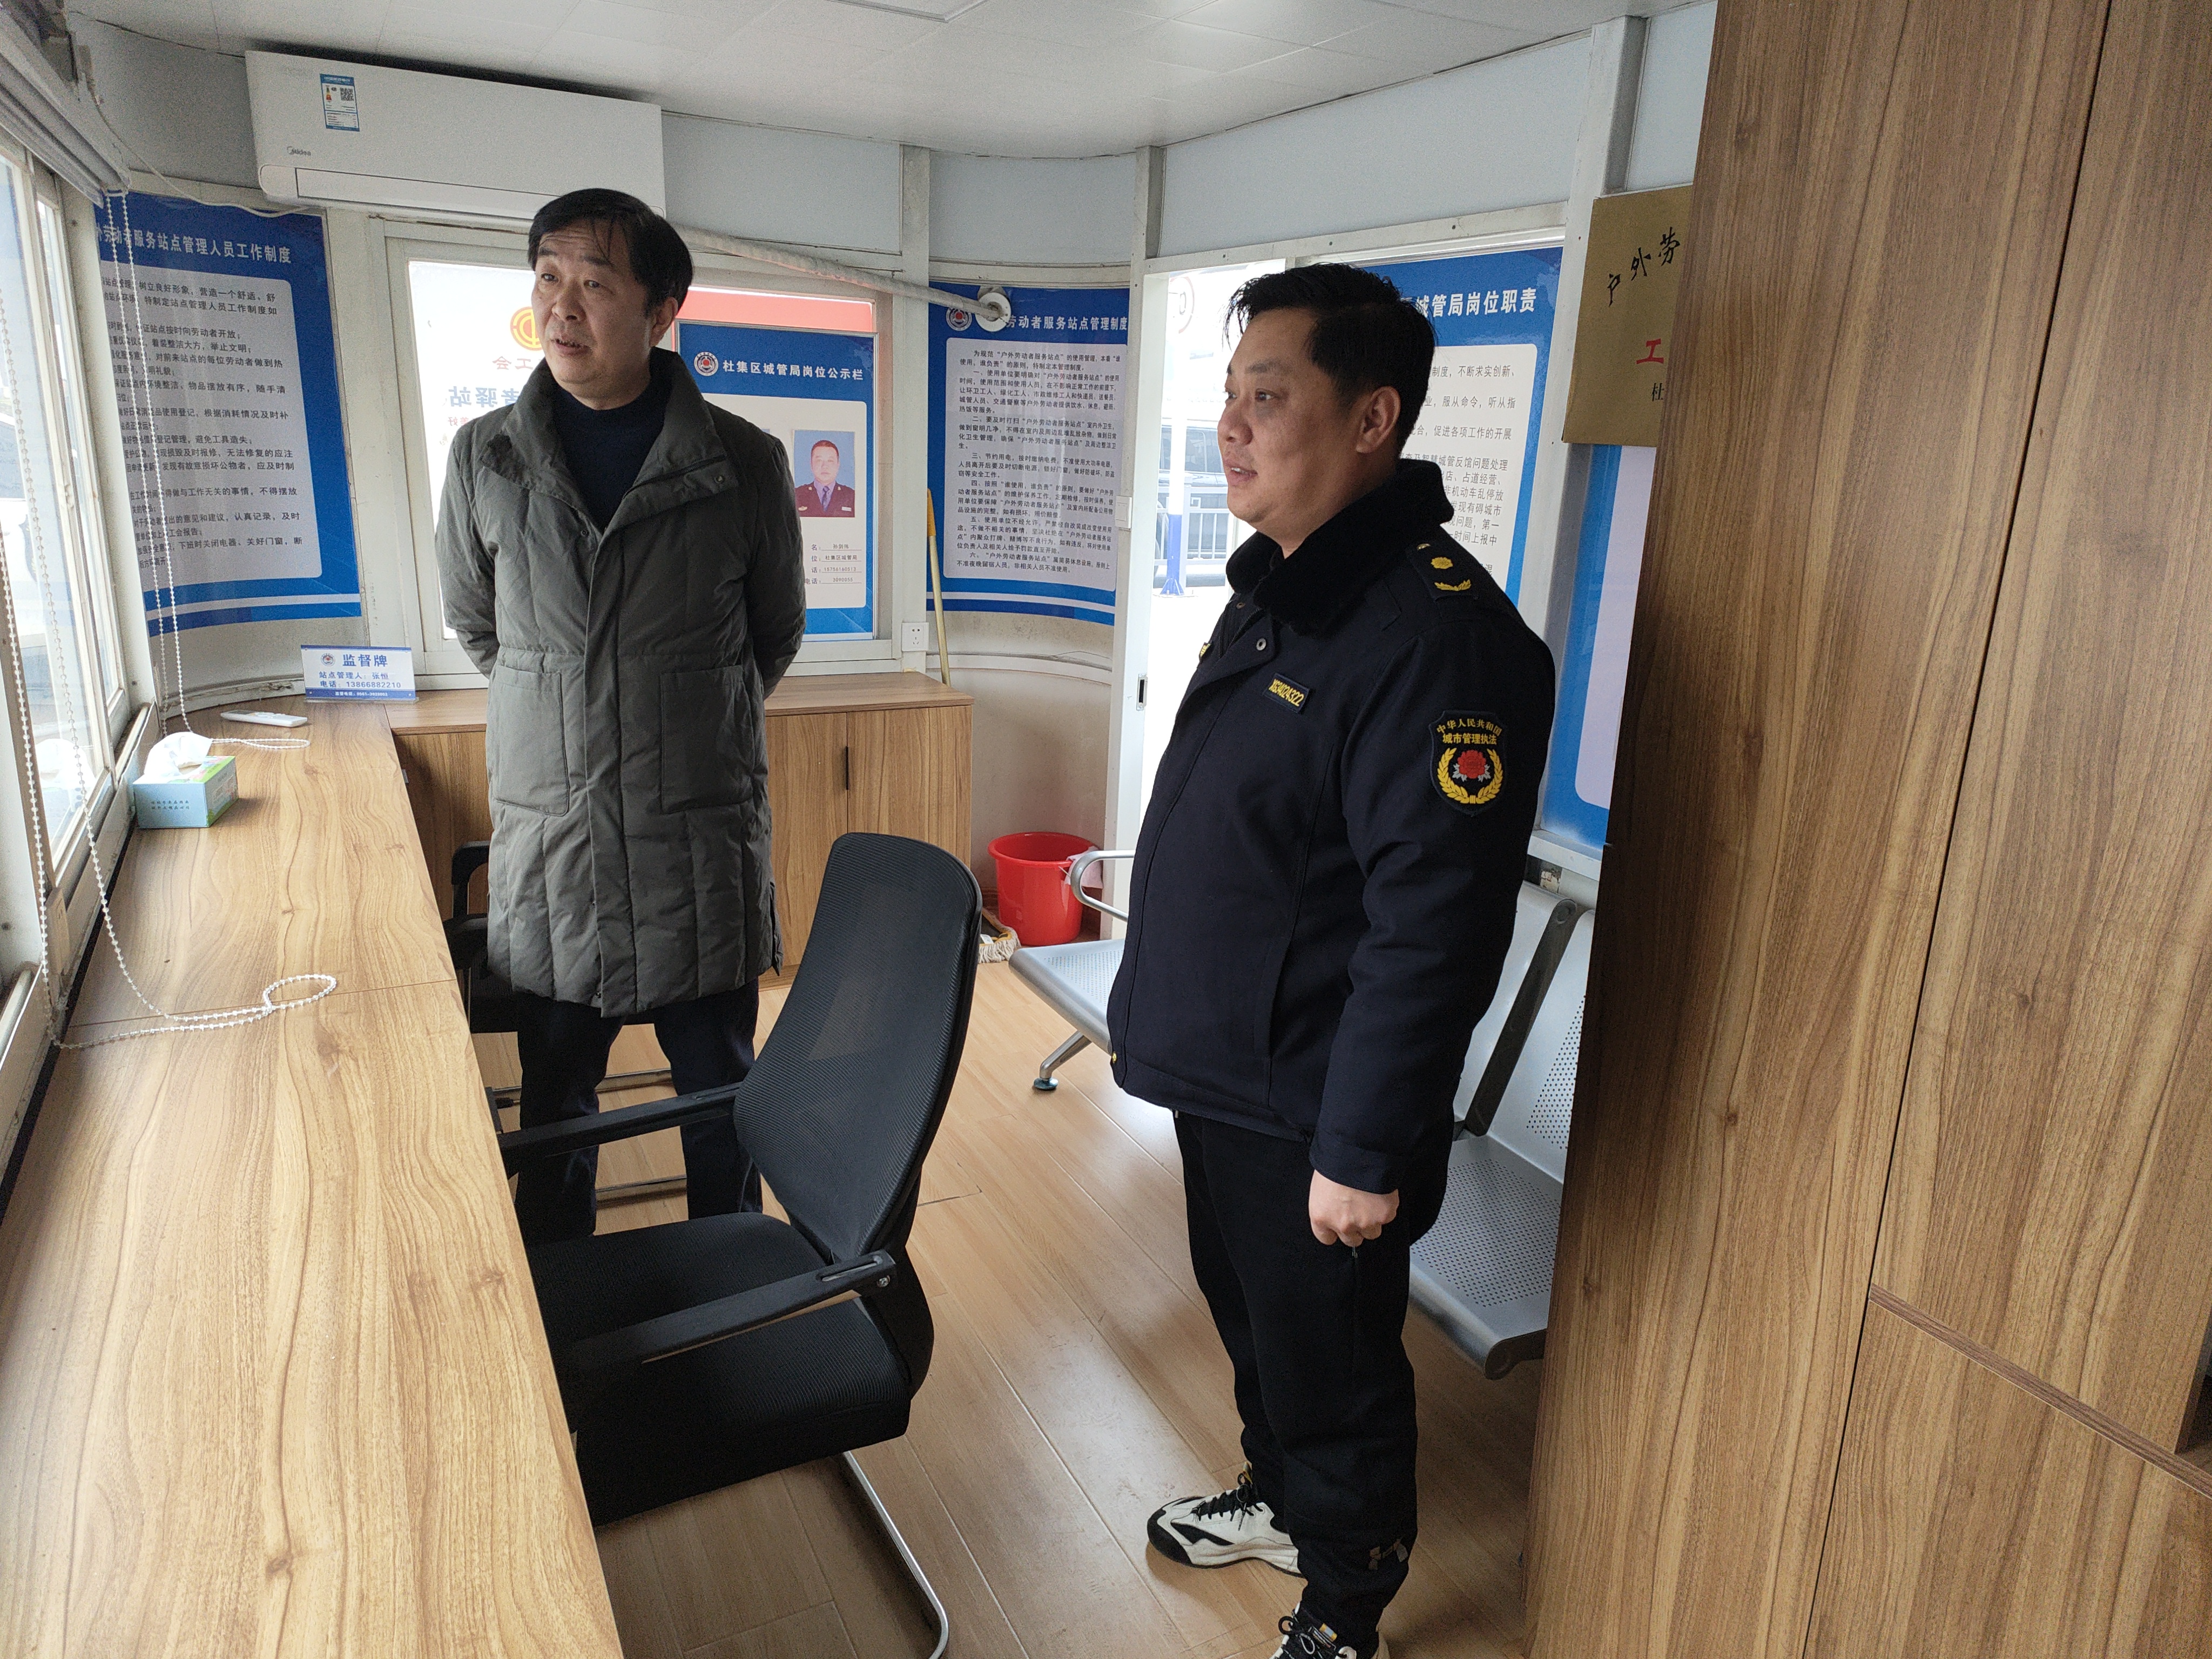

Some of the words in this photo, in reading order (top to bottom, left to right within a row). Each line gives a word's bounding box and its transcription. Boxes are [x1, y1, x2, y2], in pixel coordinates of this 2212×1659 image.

[1399, 287, 1537, 318] 城管局岗位职责
[1007, 314, 1128, 331] 劳动者服务站点管理制度
[1636, 338, 1664, 365] 工
[723, 360, 864, 381] 杜集区城管局岗位公示栏
[1443, 514, 1500, 531] 现问题，第一
[342, 653, 388, 667] 监督牌
[1437, 718, 1502, 737] 中华人民共和国
[1442, 732, 1498, 745] 城市管理执法
